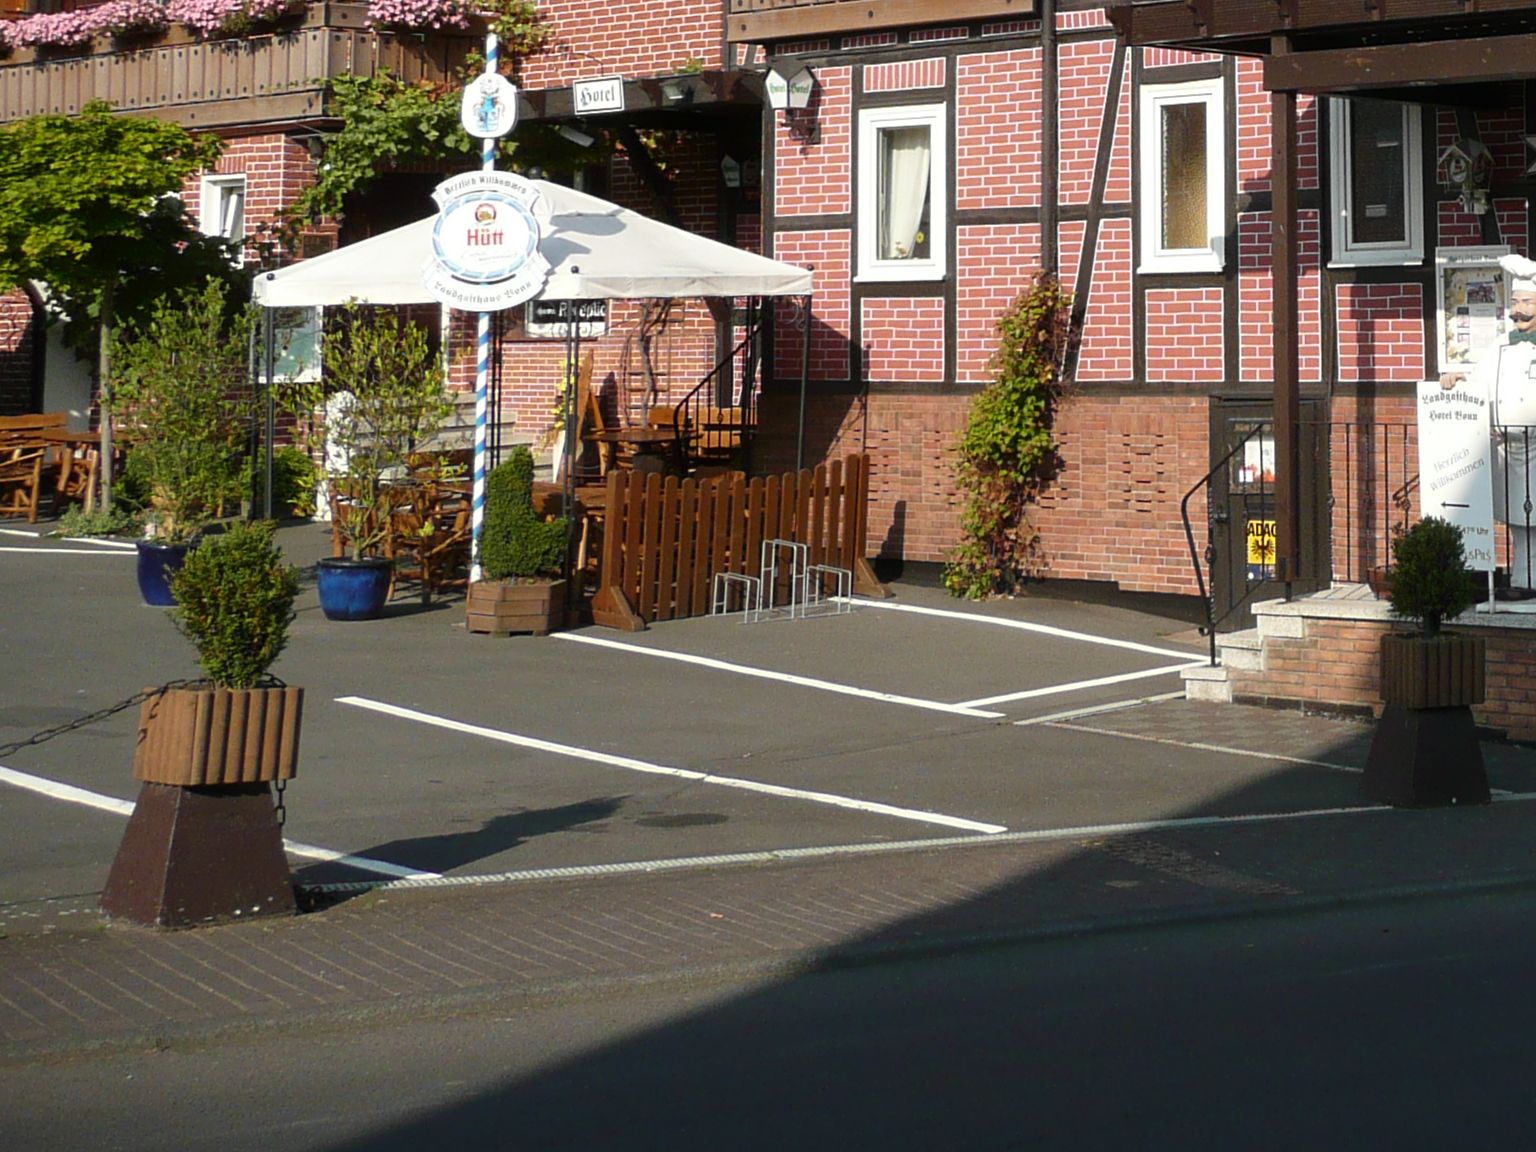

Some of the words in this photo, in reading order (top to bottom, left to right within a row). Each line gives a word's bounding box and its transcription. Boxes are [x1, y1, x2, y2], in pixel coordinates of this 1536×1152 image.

[580, 85, 615, 107] Hotel
[467, 228, 504, 246] Hütt
[1429, 410, 1452, 421] Hotel
[1455, 410, 1478, 421] Bonn
